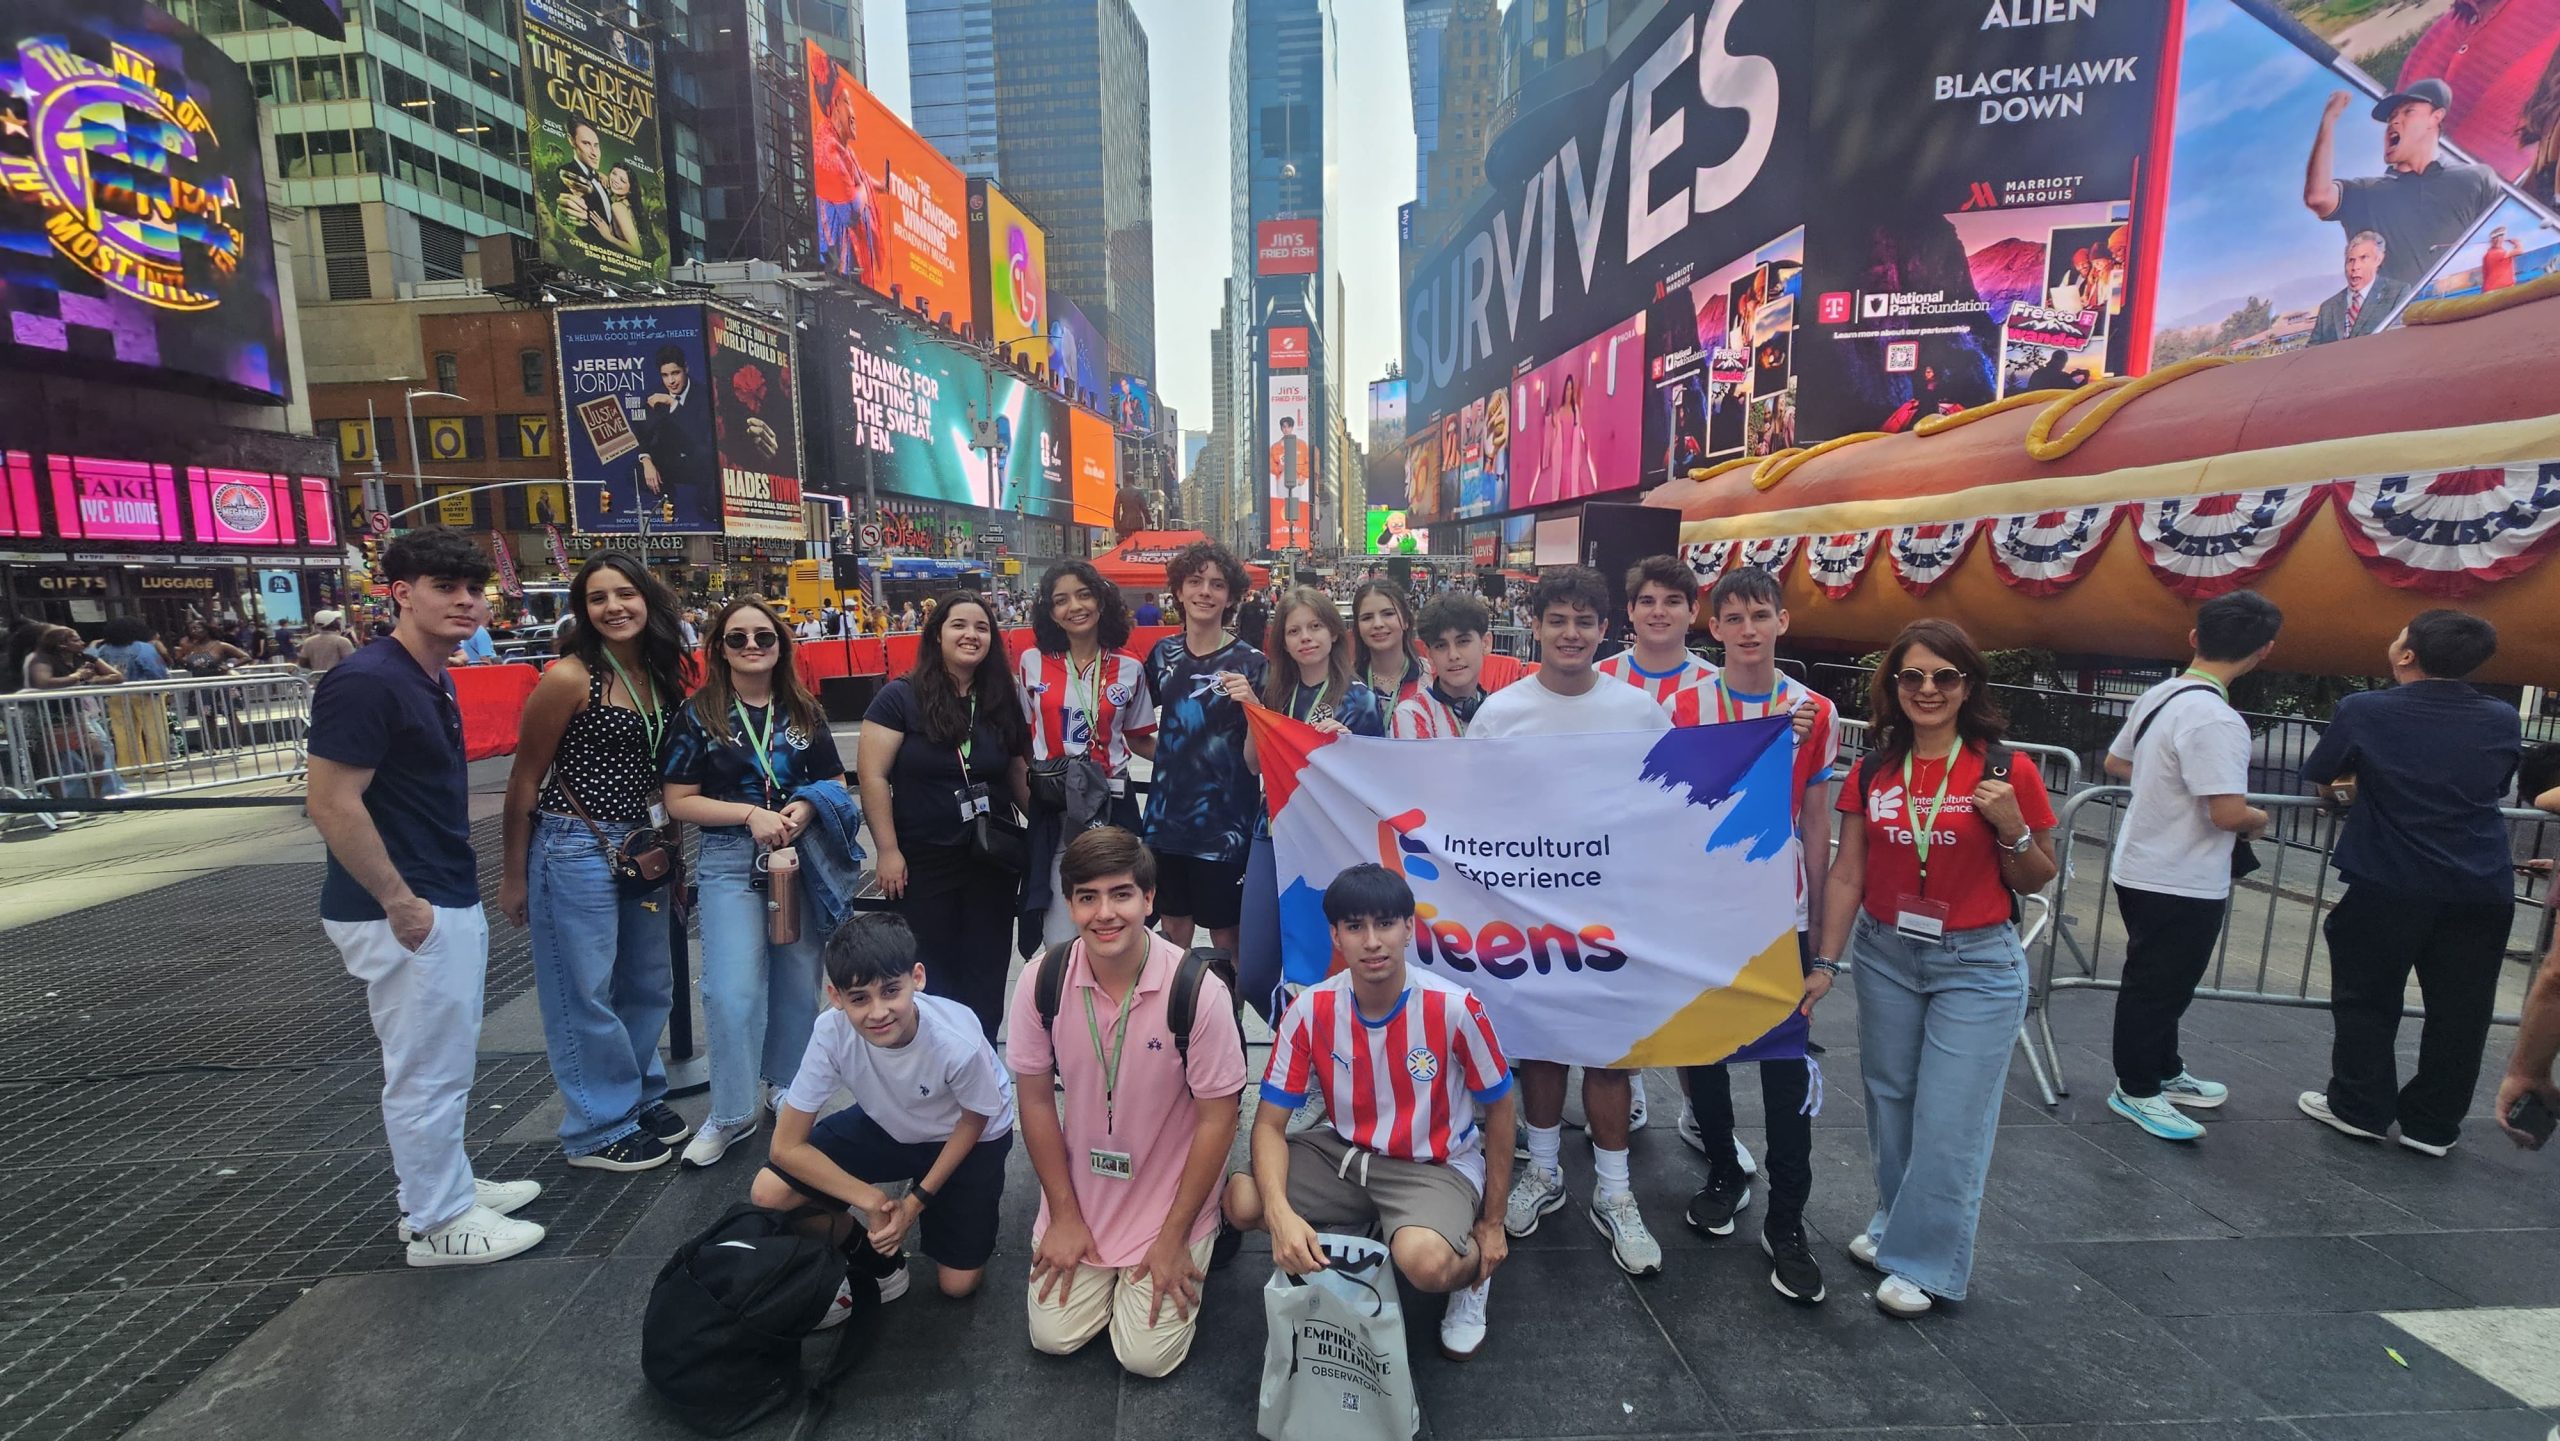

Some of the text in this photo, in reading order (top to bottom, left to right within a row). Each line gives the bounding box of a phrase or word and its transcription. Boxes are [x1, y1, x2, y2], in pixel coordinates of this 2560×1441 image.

[565, 15, 587, 31] BLEU
[1980, 0, 2096, 30] ALIEN
[523, 20, 654, 88] THE PARTY'S ROARING ON BROADWAY
[530, 38, 654, 119] THE GREAT
[1935, 56, 2139, 101] BLACK HAWK
[177, 107, 205, 132] OF
[547, 78, 644, 139] GATSBY
[1980, 92, 2083, 125] DOWN
[0, 155, 61, 206] THE
[915, 175, 931, 199] THE
[2006, 176, 2084, 192] MARRIOTT
[890, 171, 961, 240] TONY AWARD-
[1409, 0, 1779, 405] SURVIVES
[2005, 189, 2073, 204] MARQUIS
[902, 203, 948, 254] WINNING
[971, 212, 984, 222] LG
[46, 211, 134, 282] MOST
[894, 221, 957, 274] BROADWAY MUSICAL
[1270, 233, 1304, 247] Jin's
[589, 244, 625, 260] BROADWAY
[625, 255, 652, 269] THEATRE
[607, 256, 641, 272] BROADWAY
[1260, 247, 1315, 259] FRIED FISH
[1665, 262, 1695, 284] MARRIOTT
[1665, 274, 1691, 295] MARQUIS
[1889, 299, 1990, 317] Park Foundation
[1890, 290, 1944, 305] National
[2012, 303, 2055, 320] Free
[2057, 311, 2076, 323] to
[574, 334, 603, 342] HELLUVA
[604, 332, 629, 340] GOOD
[630, 331, 646, 340] TIME
[724, 317, 778, 348] COME SEE HOW THE
[1880, 328, 1905, 337] about
[1920, 325, 1971, 337] partnership
[2008, 328, 2088, 349] wander
[713, 327, 788, 369] WORLD COULD BE
[572, 356, 645, 372] JEREMY
[850, 345, 939, 401] THANKS FOR
[573, 371, 645, 393] JORDAN
[1279, 386, 1301, 396] Jin's
[852, 371, 932, 419] PUTTING IN
[587, 405, 613, 427] JUST
[590, 416, 627, 440] TIME
[853, 397, 935, 446] THE SWEAT,
[723, 468, 801, 505] HADESTOWN
[113, 502, 159, 525] HOME
[544, 537, 592, 551] GFTS
[40, 576, 108, 589] GIFTS
[141, 577, 214, 590] LUGGAGE
[1061, 706, 1090, 745] 12
[1916, 804, 1973, 816] Exprience
[1444, 834, 1610, 859] Intercultural
[1883, 826, 1957, 845] Tens
[1454, 862, 1602, 890] Experience
[1342, 1326, 1357, 1341] THE
[1304, 1326, 1391, 1375] EMPIRE STATE
[1318, 1342, 1380, 1382] BUILDIN
[1311, 1365, 1381, 1398] OBSERVATORY
